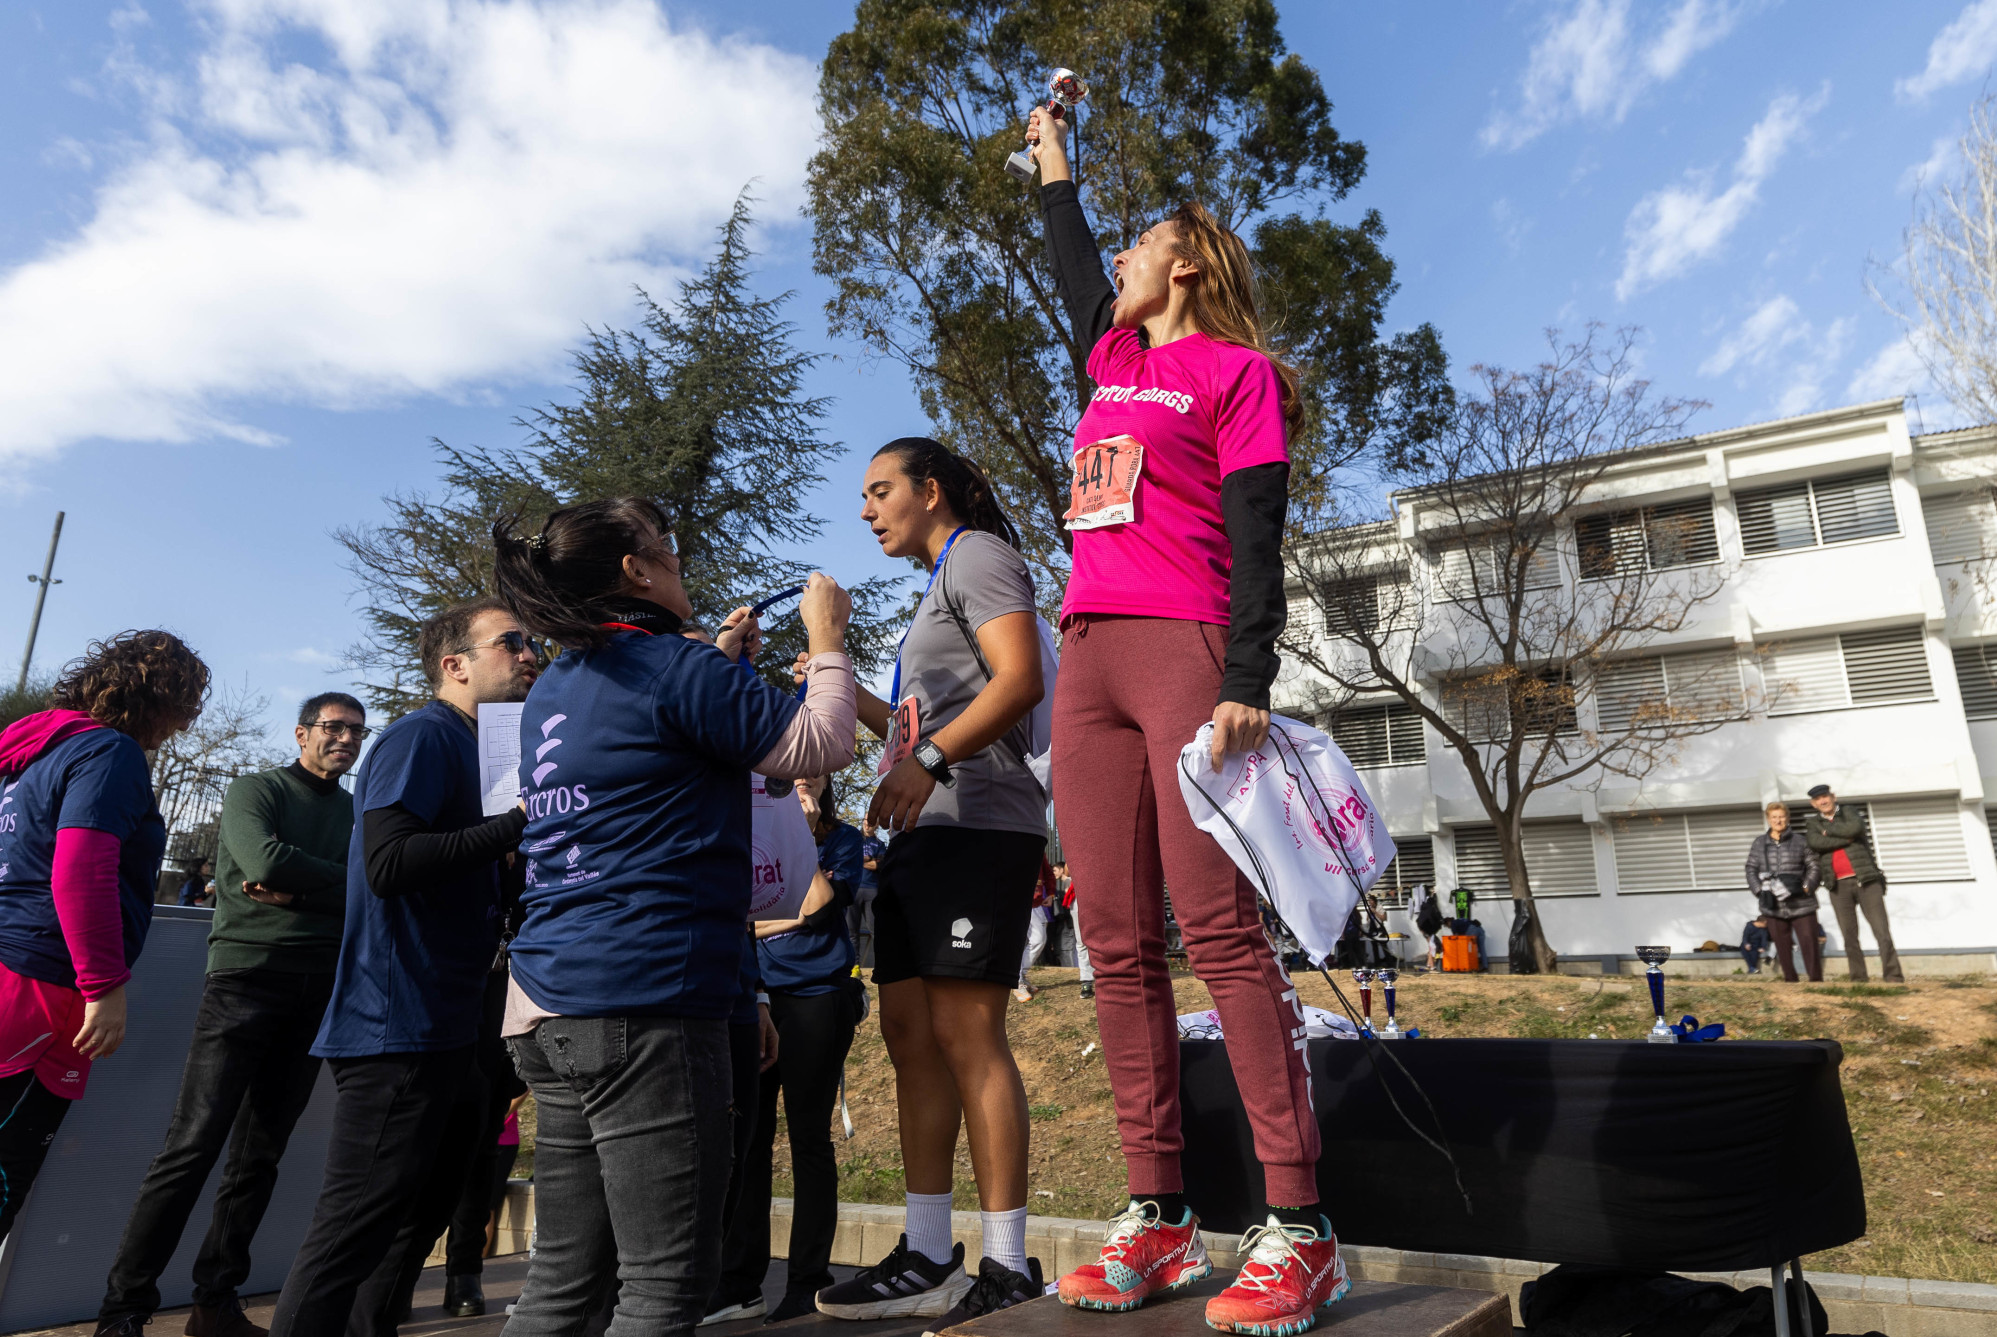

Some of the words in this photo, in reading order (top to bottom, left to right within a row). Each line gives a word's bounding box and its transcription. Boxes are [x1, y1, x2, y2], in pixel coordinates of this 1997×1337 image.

[1132, 387, 1194, 414] GORGS
[1078, 446, 1118, 495] 447
[893, 705, 911, 750] 69
[1240, 751, 1267, 796] AMPA
[521, 784, 589, 822] Ercros
[1283, 782, 1295, 800] del
[1325, 862, 1342, 875] VII
[952, 939, 972, 949] soka
